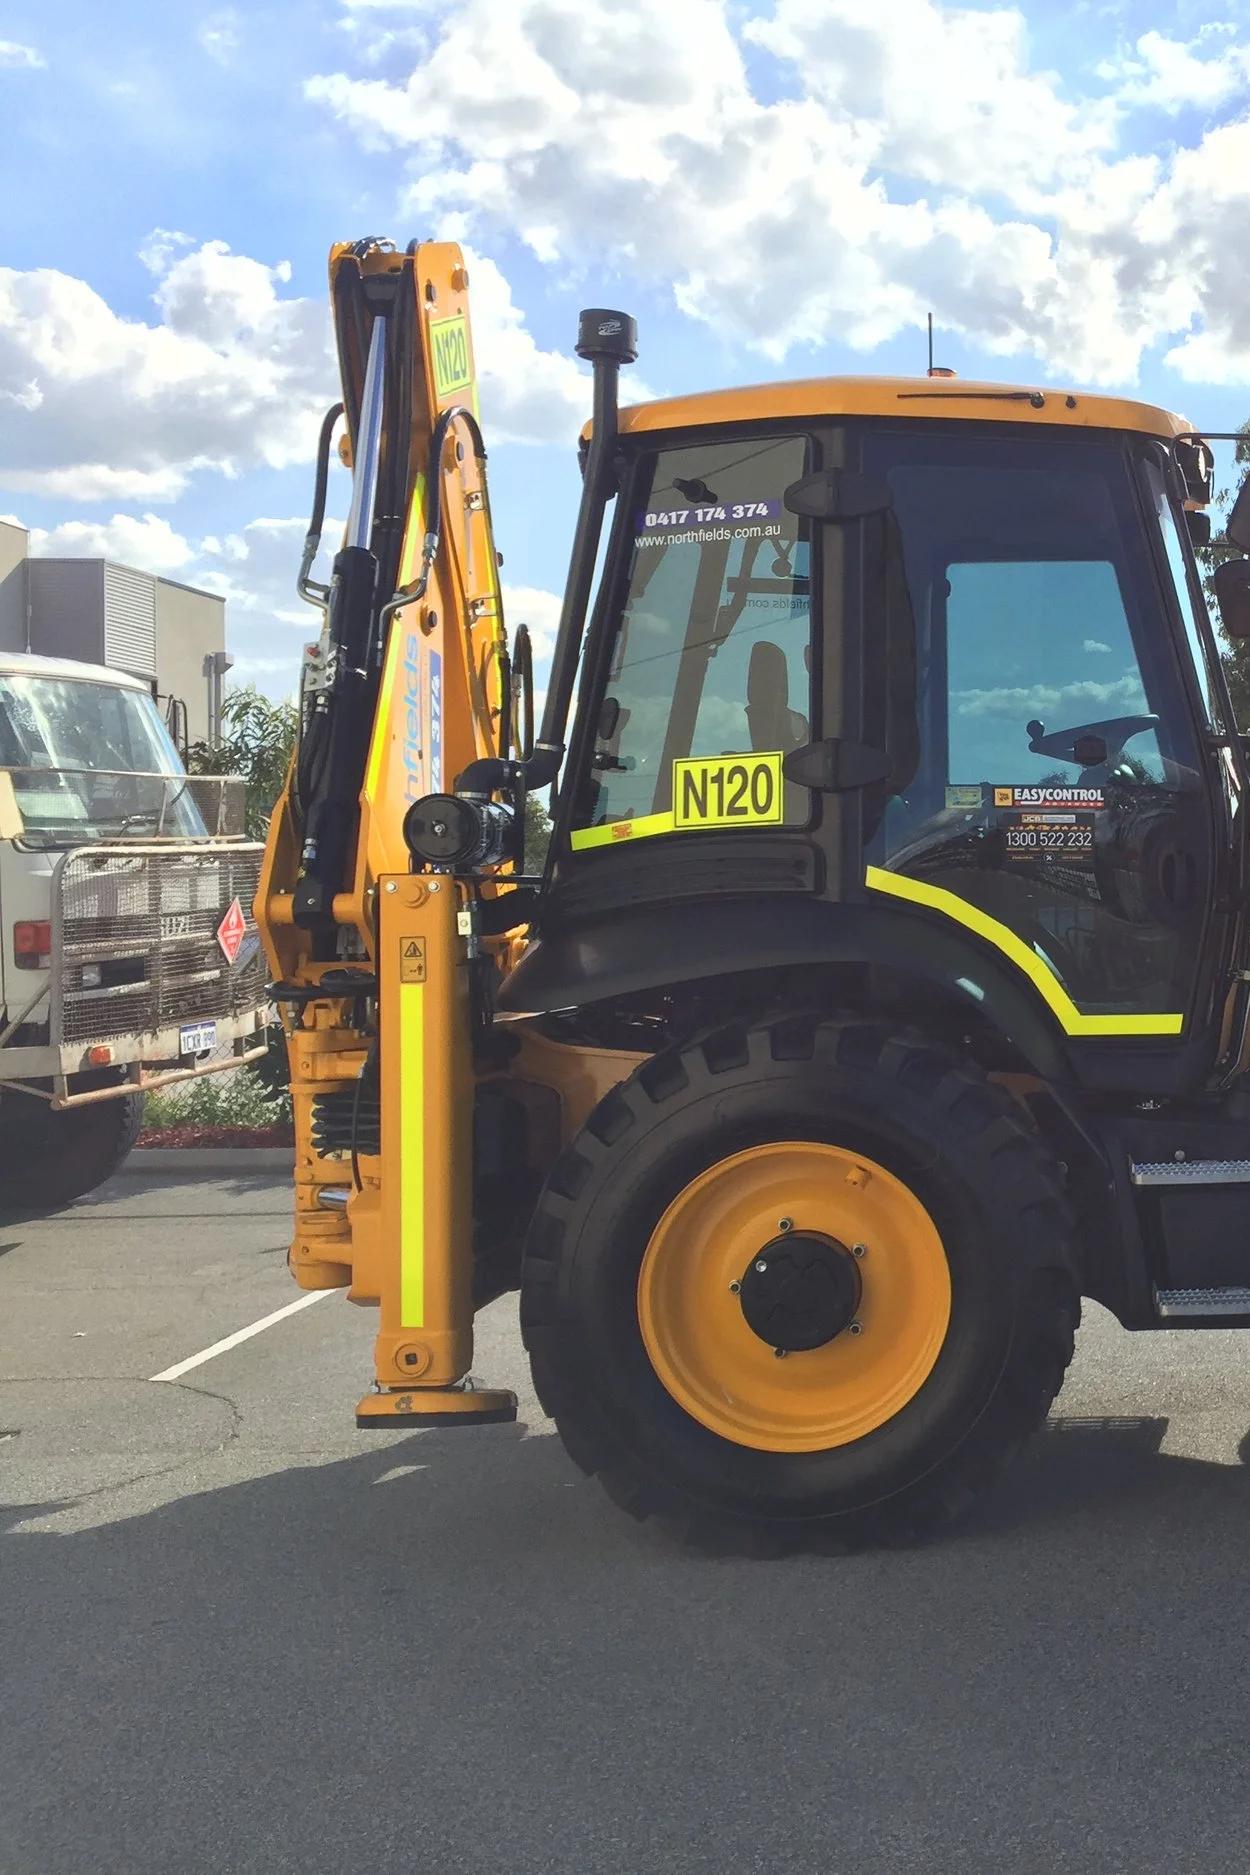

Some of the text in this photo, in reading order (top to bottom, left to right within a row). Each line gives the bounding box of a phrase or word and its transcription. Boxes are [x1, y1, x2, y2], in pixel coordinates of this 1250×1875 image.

[435, 327, 467, 387] N120
[645, 502, 768, 527] 0417 174 374
[634, 524, 781, 548] www.northfields.com.au
[431, 674, 441, 744] 374
[683, 763, 773, 819] N120
[1014, 788, 1104, 802] EASYCONTROL
[1006, 832, 1092, 846] 1300 522 232
